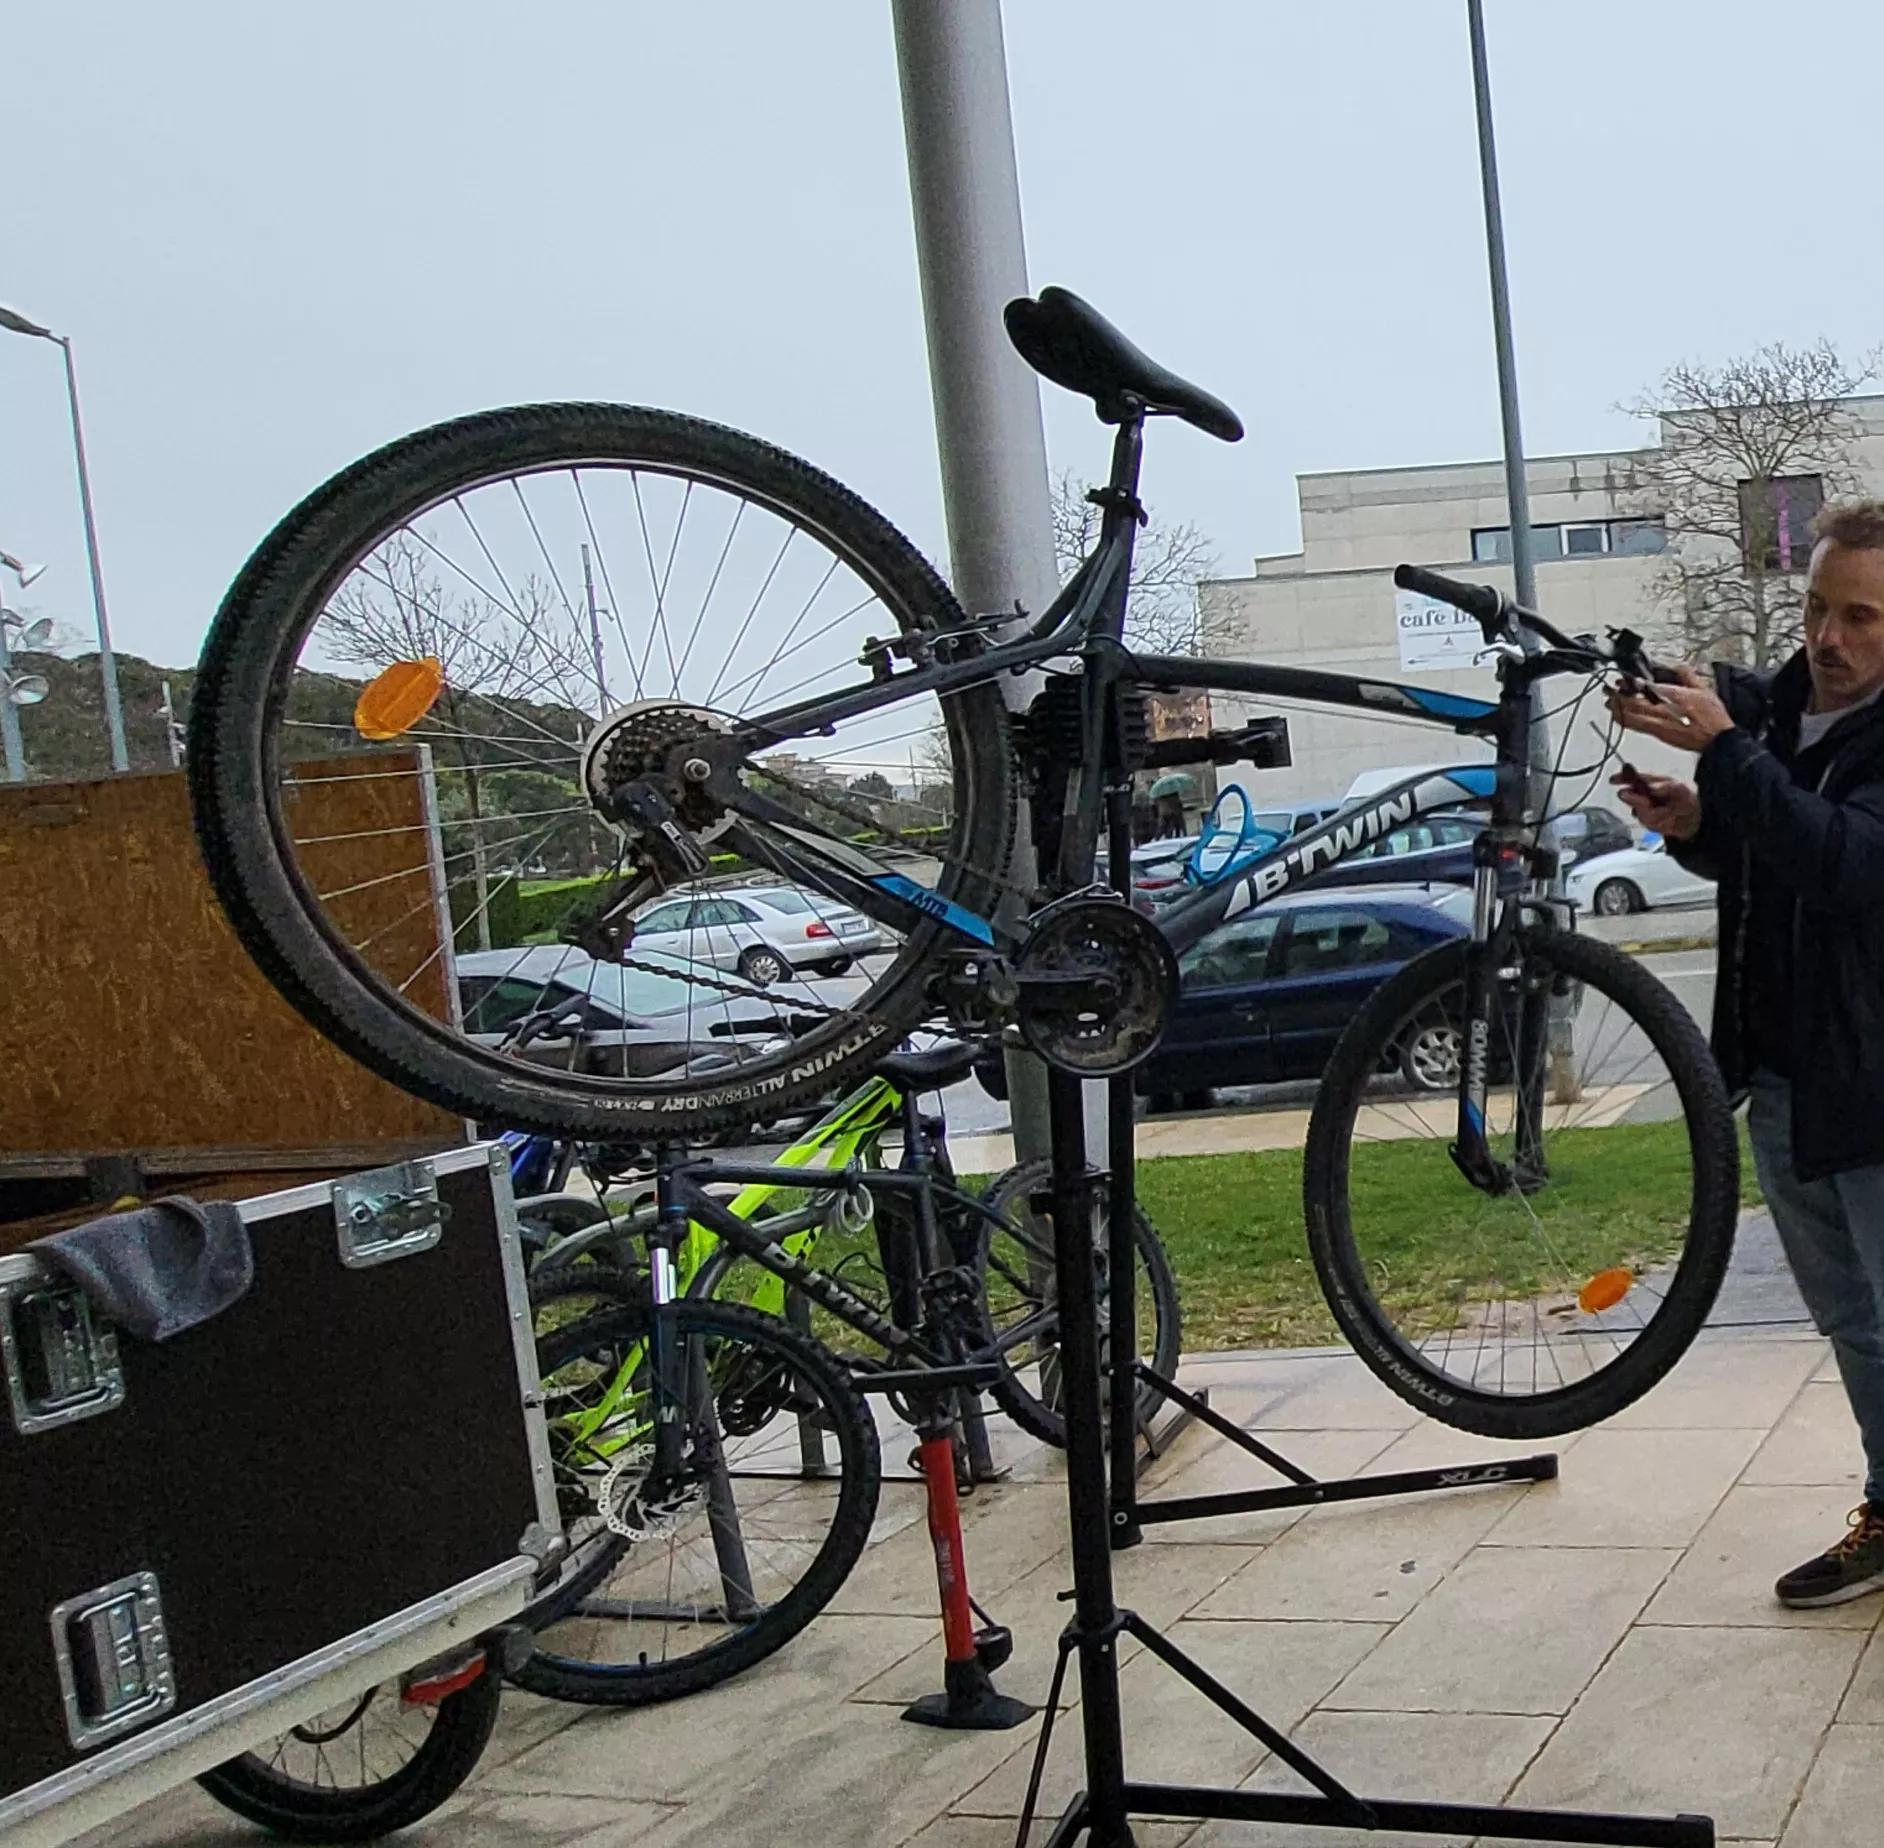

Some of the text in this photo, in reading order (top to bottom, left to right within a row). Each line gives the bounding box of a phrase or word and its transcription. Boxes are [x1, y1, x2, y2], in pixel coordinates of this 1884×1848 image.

[1400, 609, 1446, 628] café
[1254, 791, 1412, 900] B'TWIN
[1436, 1467, 1508, 1486] XLC
